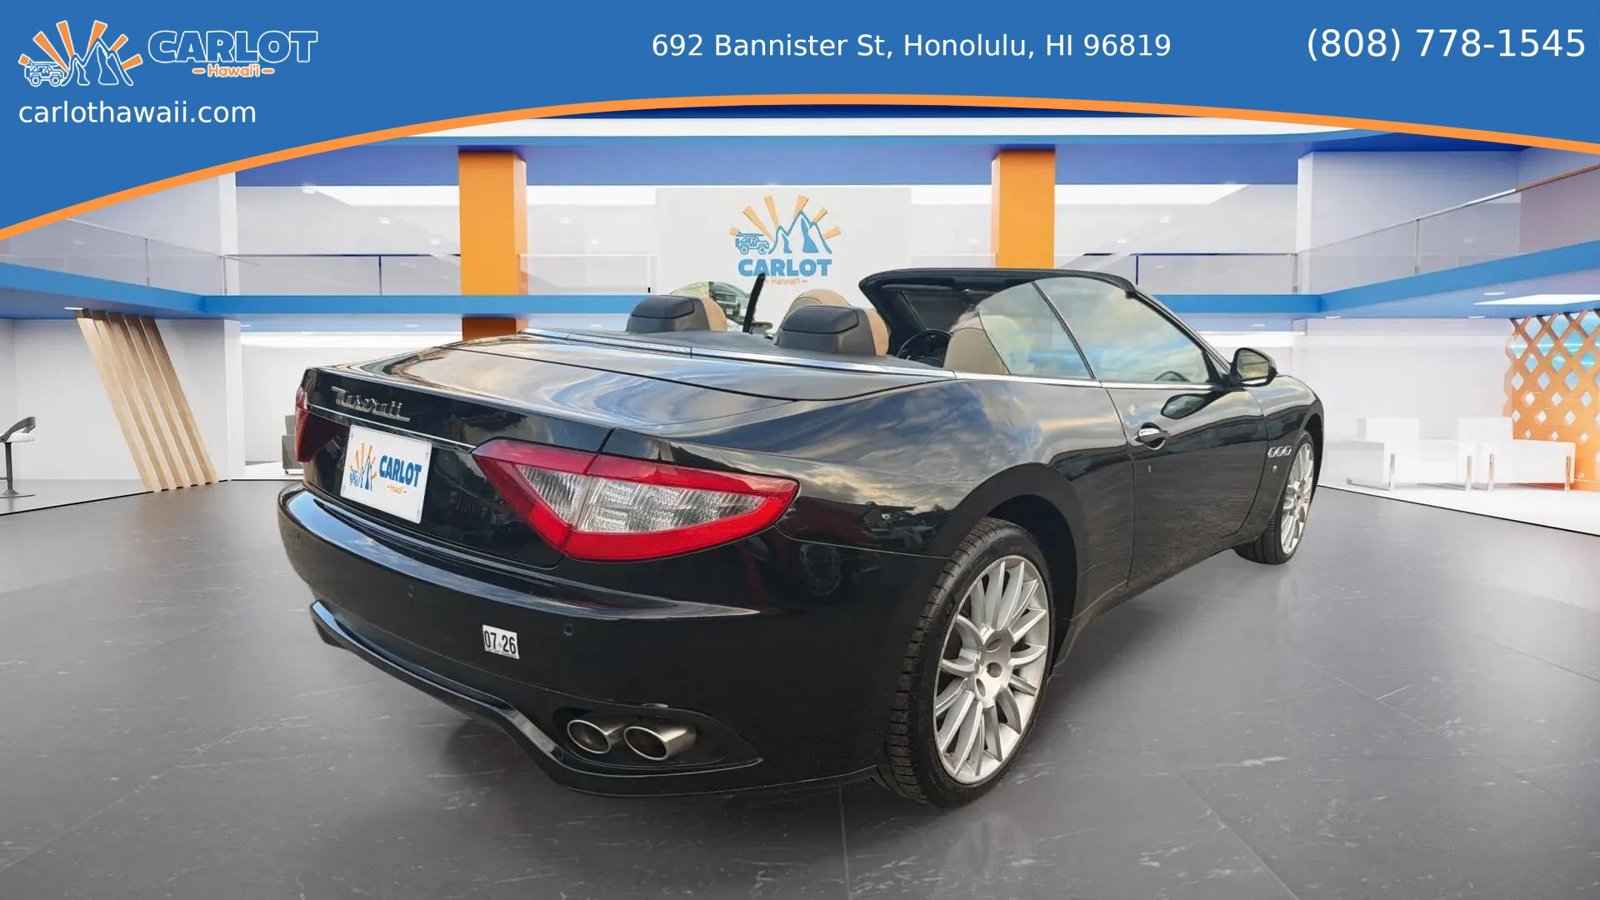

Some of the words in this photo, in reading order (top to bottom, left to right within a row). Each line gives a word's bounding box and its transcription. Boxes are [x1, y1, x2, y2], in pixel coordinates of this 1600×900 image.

[738, 258, 832, 277] CARLOT
[379, 455, 422, 487] CARLOT
[484, 630, 497, 649] 07
[501, 634, 516, 654] 26
